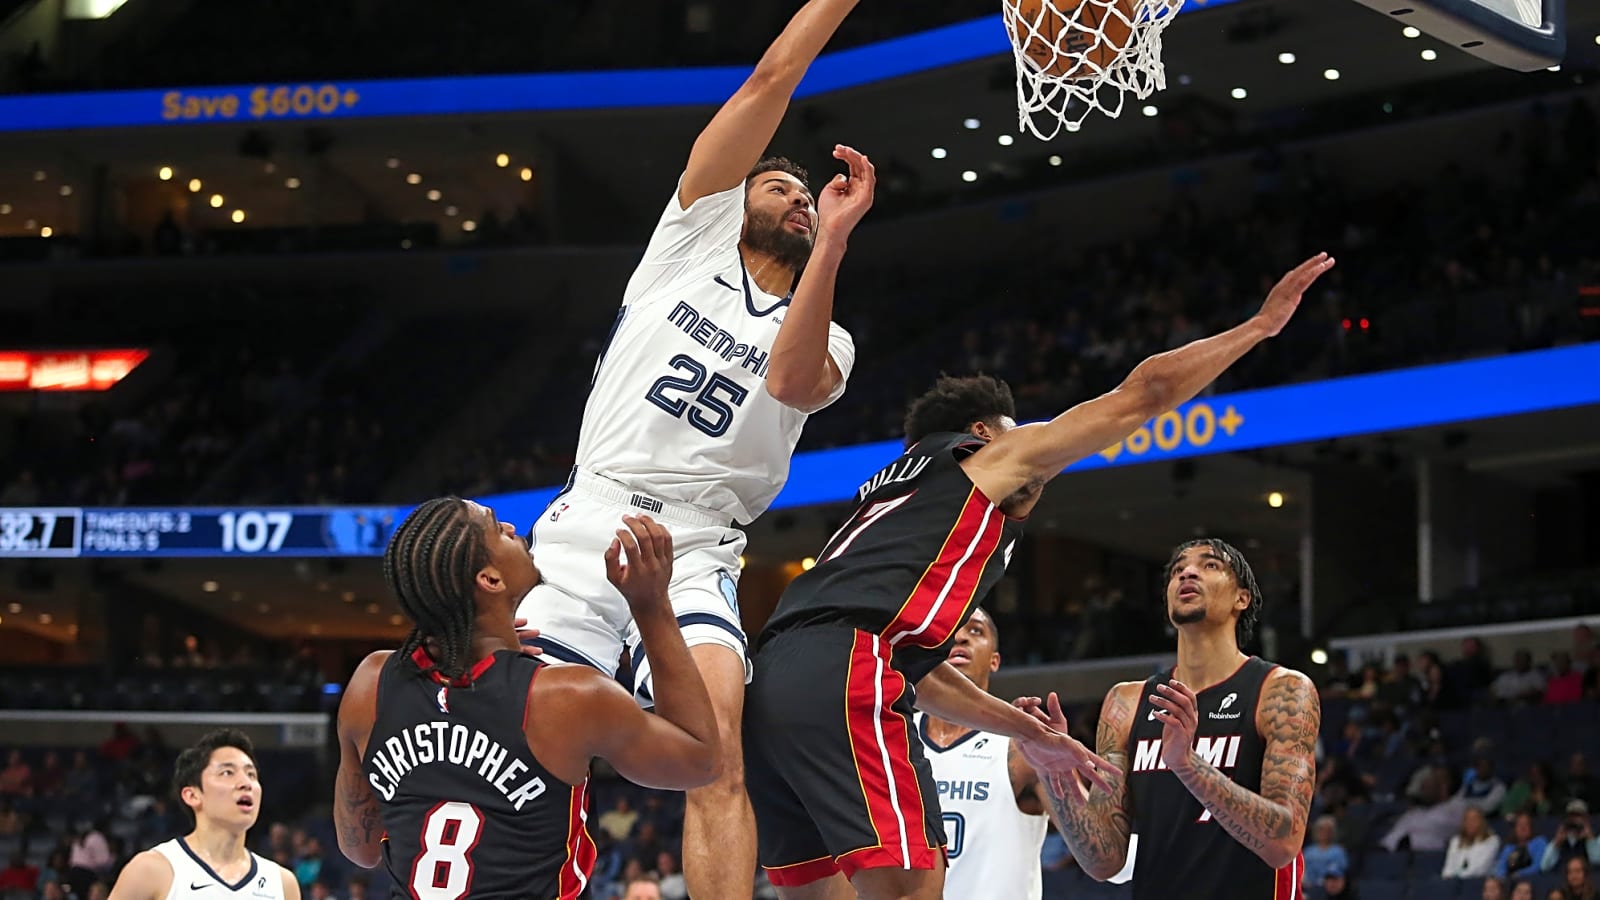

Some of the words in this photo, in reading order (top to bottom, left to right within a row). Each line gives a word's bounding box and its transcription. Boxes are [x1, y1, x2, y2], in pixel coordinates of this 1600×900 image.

[162, 90, 240, 120] Save
[250, 84, 360, 118] $600+
[667, 300, 769, 380] MEMPHI
[645, 353, 749, 437] 25
[219, 512, 293, 552] 107
[369, 721, 547, 812] CHRISTOPHER
[1132, 735, 1242, 772] MMI
[936, 780, 990, 801] PHIS
[408, 800, 486, 900] 8
